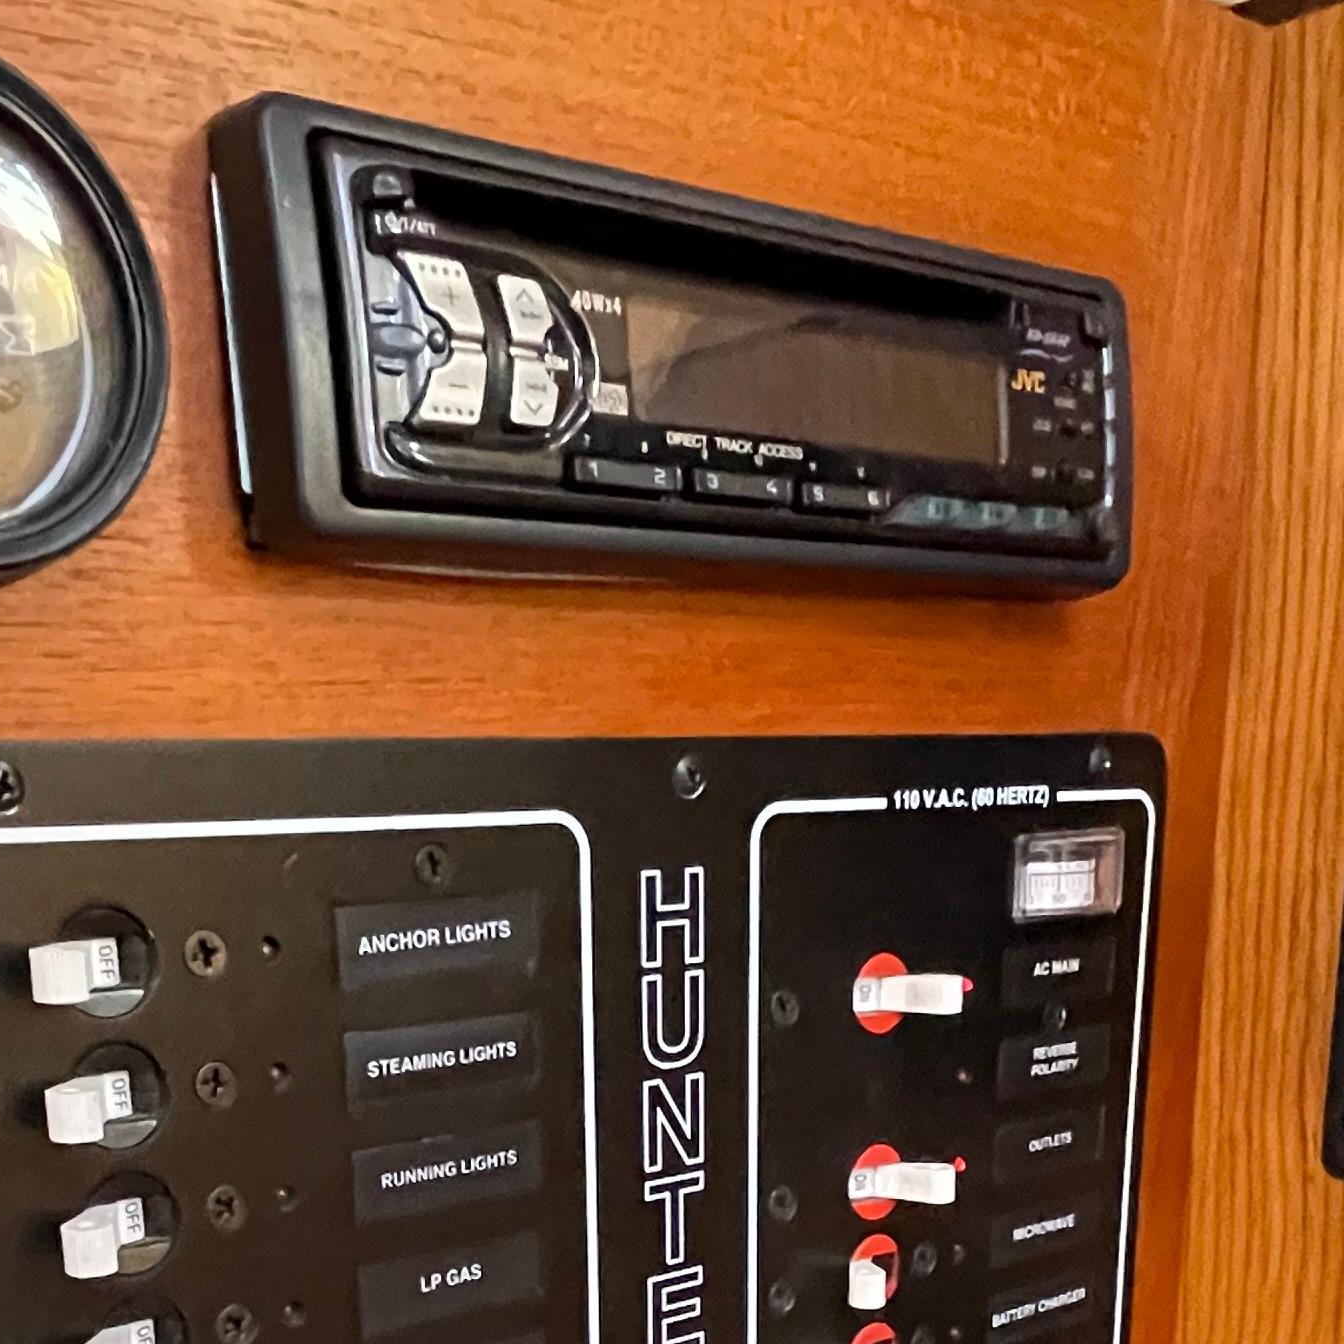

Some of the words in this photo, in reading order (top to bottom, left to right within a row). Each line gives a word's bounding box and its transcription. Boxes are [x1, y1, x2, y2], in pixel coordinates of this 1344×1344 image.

[1011, 368, 1046, 394] JVC
[666, 431, 706, 449] DIRECT
[716, 436, 753, 454] TRACK
[758, 443, 803, 461] ACCESS
[587, 462, 598, 478] 1
[655, 467, 667, 485] 2
[706, 472, 719, 490] 3
[765, 478, 778, 494] 4
[812, 484, 824, 502] 5
[893, 789, 920, 810] 110
[922, 788, 969, 808] V.A.C.
[972, 787, 994, 811] (60
[997, 785, 1049, 808] HERTZ)
[358, 927, 441, 956] ANCHOR
[445, 919, 512, 945] LIGHTS
[97, 943, 115, 984] OFF
[1033, 962, 1050, 976] AC
[367, 1050, 456, 1079] STEAMING
[459, 1040, 518, 1066] LIGHTS
[111, 1077, 129, 1114] OFF
[1028, 1131, 1072, 1152] OUTLETS
[381, 1159, 457, 1190] RUNNING
[459, 1149, 518, 1174] LIGHTS
[124, 1202, 142, 1236] OFF
[420, 1273, 443, 1293] LP
[445, 1263, 483, 1285] GAS
